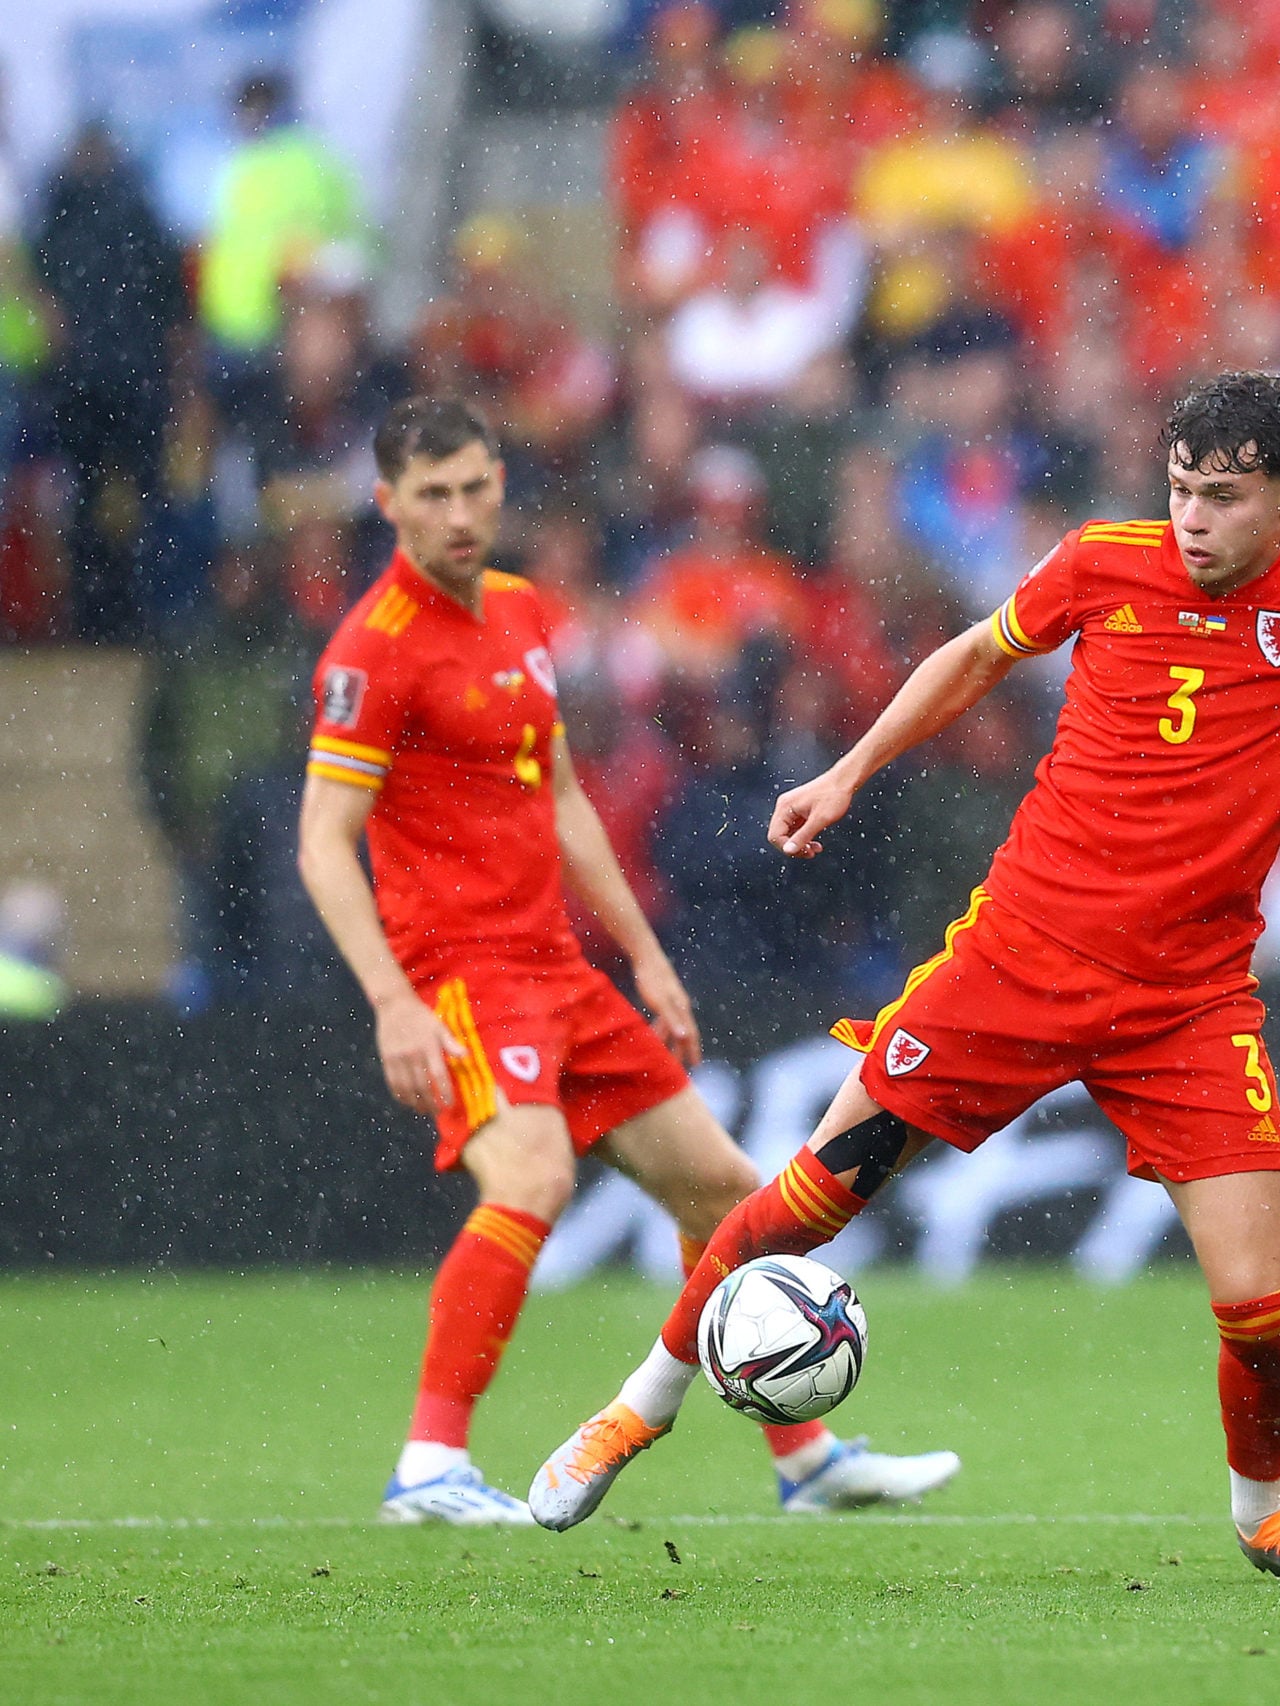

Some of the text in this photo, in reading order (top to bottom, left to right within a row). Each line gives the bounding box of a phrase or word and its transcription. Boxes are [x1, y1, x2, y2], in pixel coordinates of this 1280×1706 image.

[1103, 619, 1143, 633] adidas
[1159, 665, 1205, 744] 3
[1231, 1034, 1272, 1112] 3
